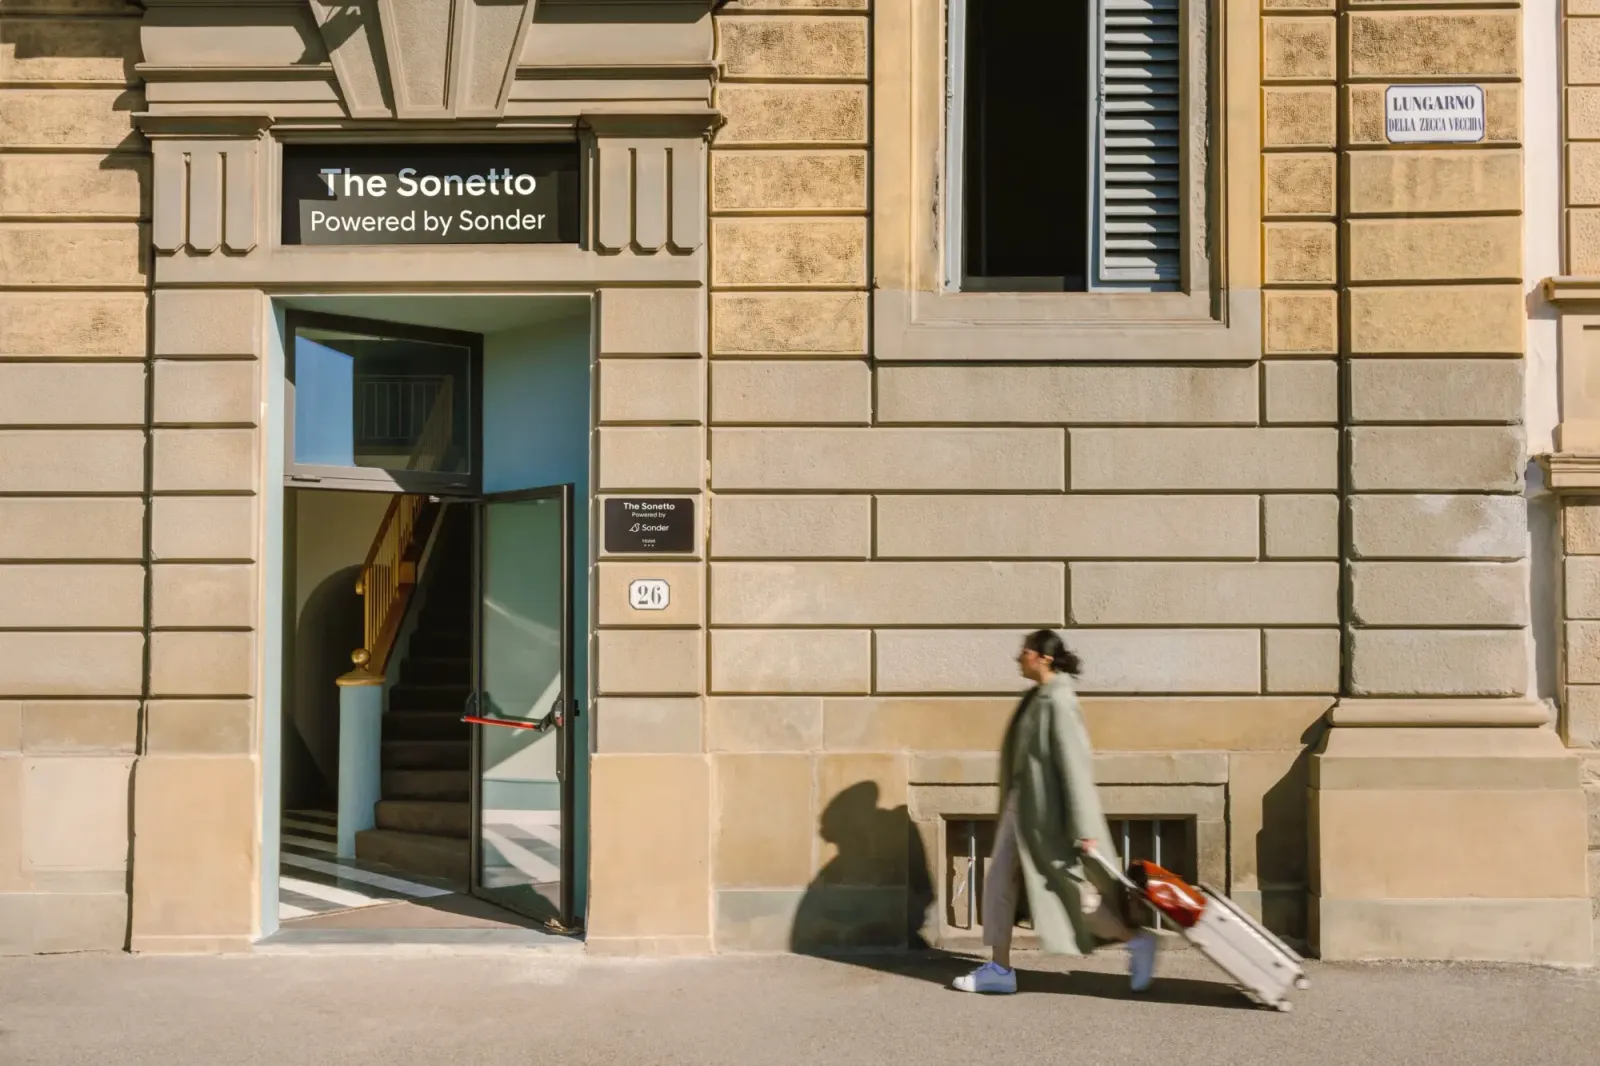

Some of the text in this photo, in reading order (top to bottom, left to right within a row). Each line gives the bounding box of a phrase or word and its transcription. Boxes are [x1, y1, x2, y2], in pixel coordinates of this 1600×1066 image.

[1393, 95, 1475, 111] LUNGARNO
[1389, 117, 1482, 132] DELLA ZECCA VECCHIA
[320, 167, 536, 197] The Sonetto
[311, 209, 546, 236] Powered by Sonder
[623, 502, 676, 510] The Sonetto
[641, 524, 670, 532] Sonder
[637, 584, 662, 605] 26
